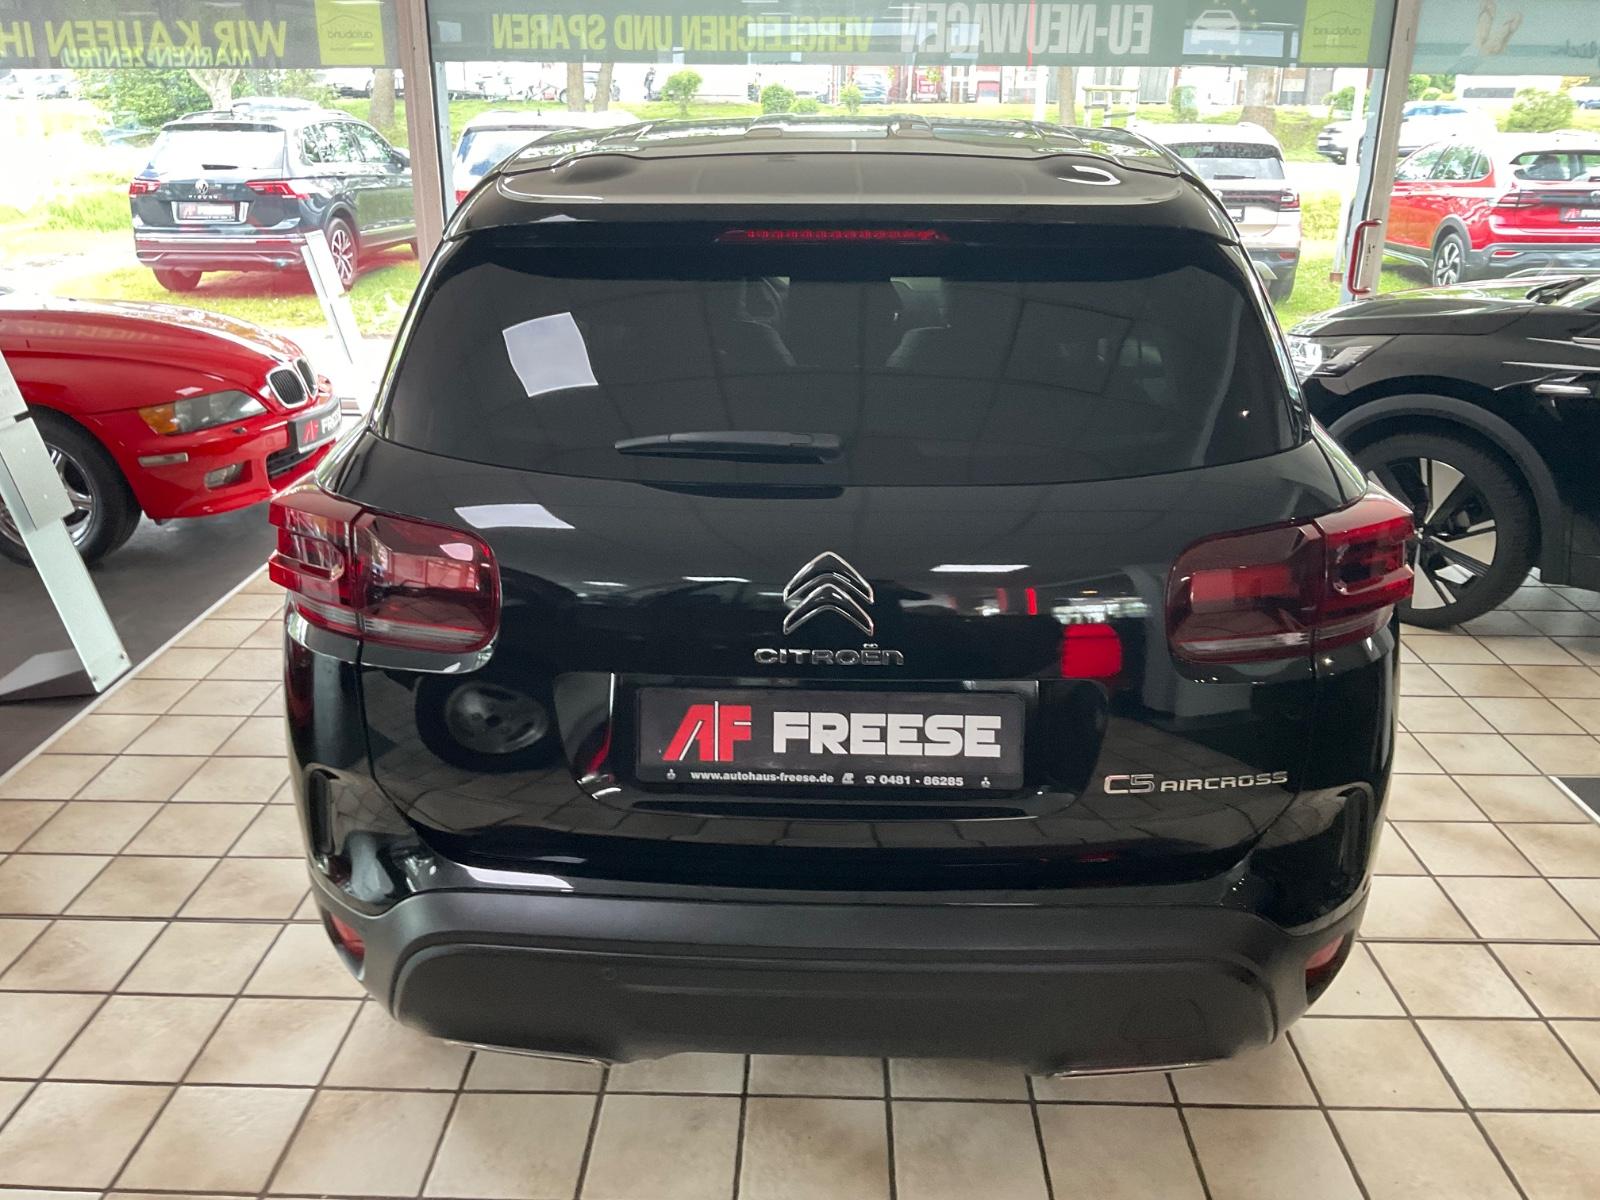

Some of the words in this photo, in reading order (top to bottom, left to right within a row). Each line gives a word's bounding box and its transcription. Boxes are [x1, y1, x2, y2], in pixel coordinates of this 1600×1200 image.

[754, 643, 905, 666] CITROËN
[662, 701, 752, 763] AF
[773, 711, 1002, 758] FREESE
[690, 769, 834, 785] www.autohaus-freese.de
[879, 774, 911, 786] 0481
[923, 776, 964, 787] 86285
[1104, 774, 1155, 794] C5
[1160, 771, 1288, 792] AIRCROSS
